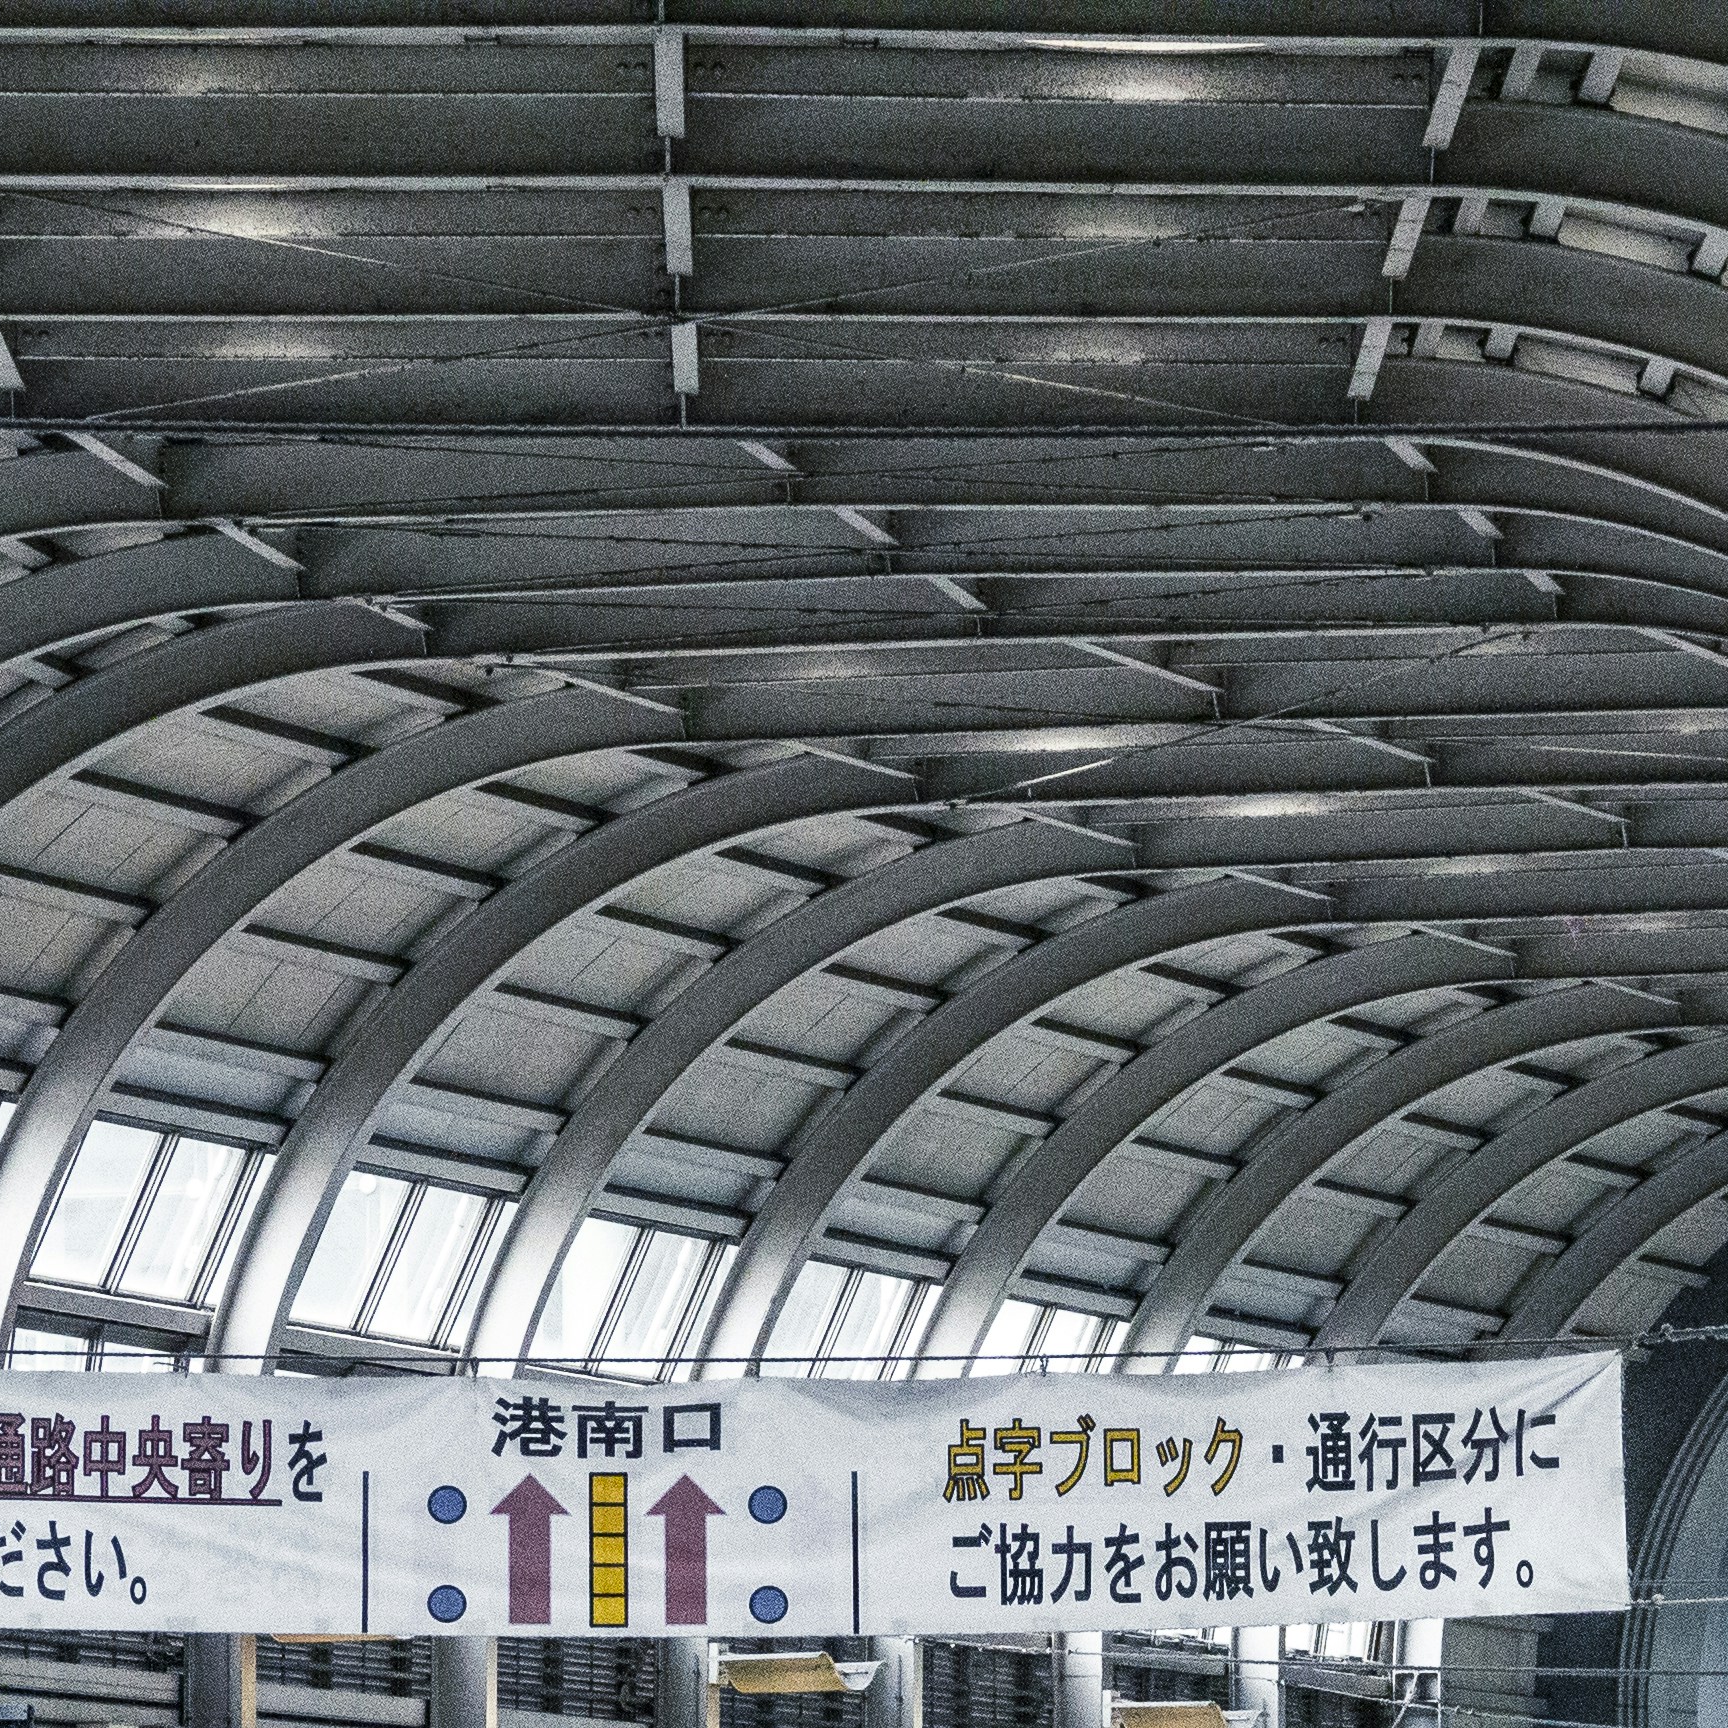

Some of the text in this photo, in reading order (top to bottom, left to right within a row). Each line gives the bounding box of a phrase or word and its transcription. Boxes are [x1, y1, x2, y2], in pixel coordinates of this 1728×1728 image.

[492, 1397, 722, 1459] 港南口
[942, 1408, 1560, 1502] 点字ブロック・通行区分に
[949, 1508, 1534, 1604] ご協力をお願い致します。
